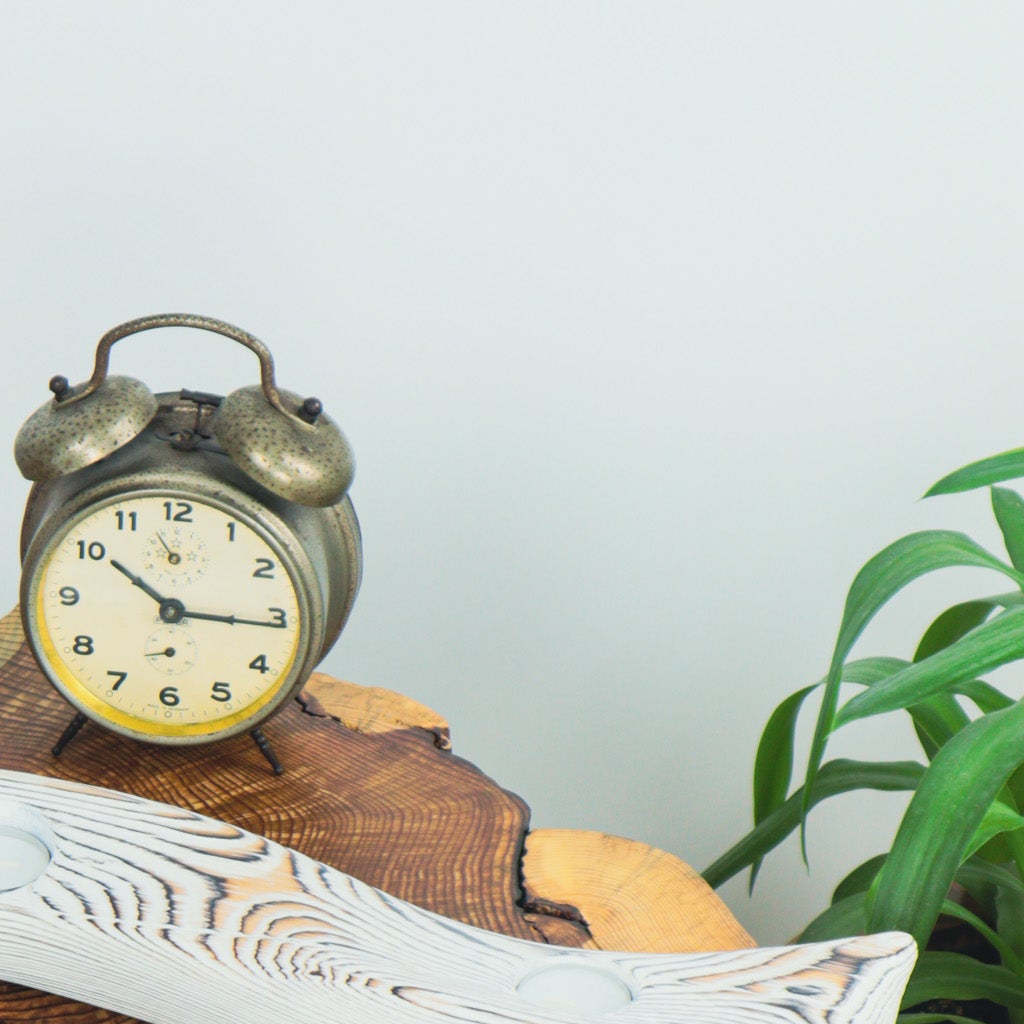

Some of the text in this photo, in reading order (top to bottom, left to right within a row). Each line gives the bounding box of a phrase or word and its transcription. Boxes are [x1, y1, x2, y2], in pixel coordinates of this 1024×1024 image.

[115, 510, 137, 532] 11
[163, 502, 193, 523] 12
[226, 522, 235, 542] 1
[76, 540, 106, 561] 10
[252, 558, 275, 579] 2
[59, 586, 80, 606] 9
[267, 607, 287, 627] 3
[72, 635, 94, 656] 8
[248, 654, 270, 674] 4
[106, 670, 128, 691] 7
[159, 686, 180, 707] 6
[210, 682, 232, 703] 5
